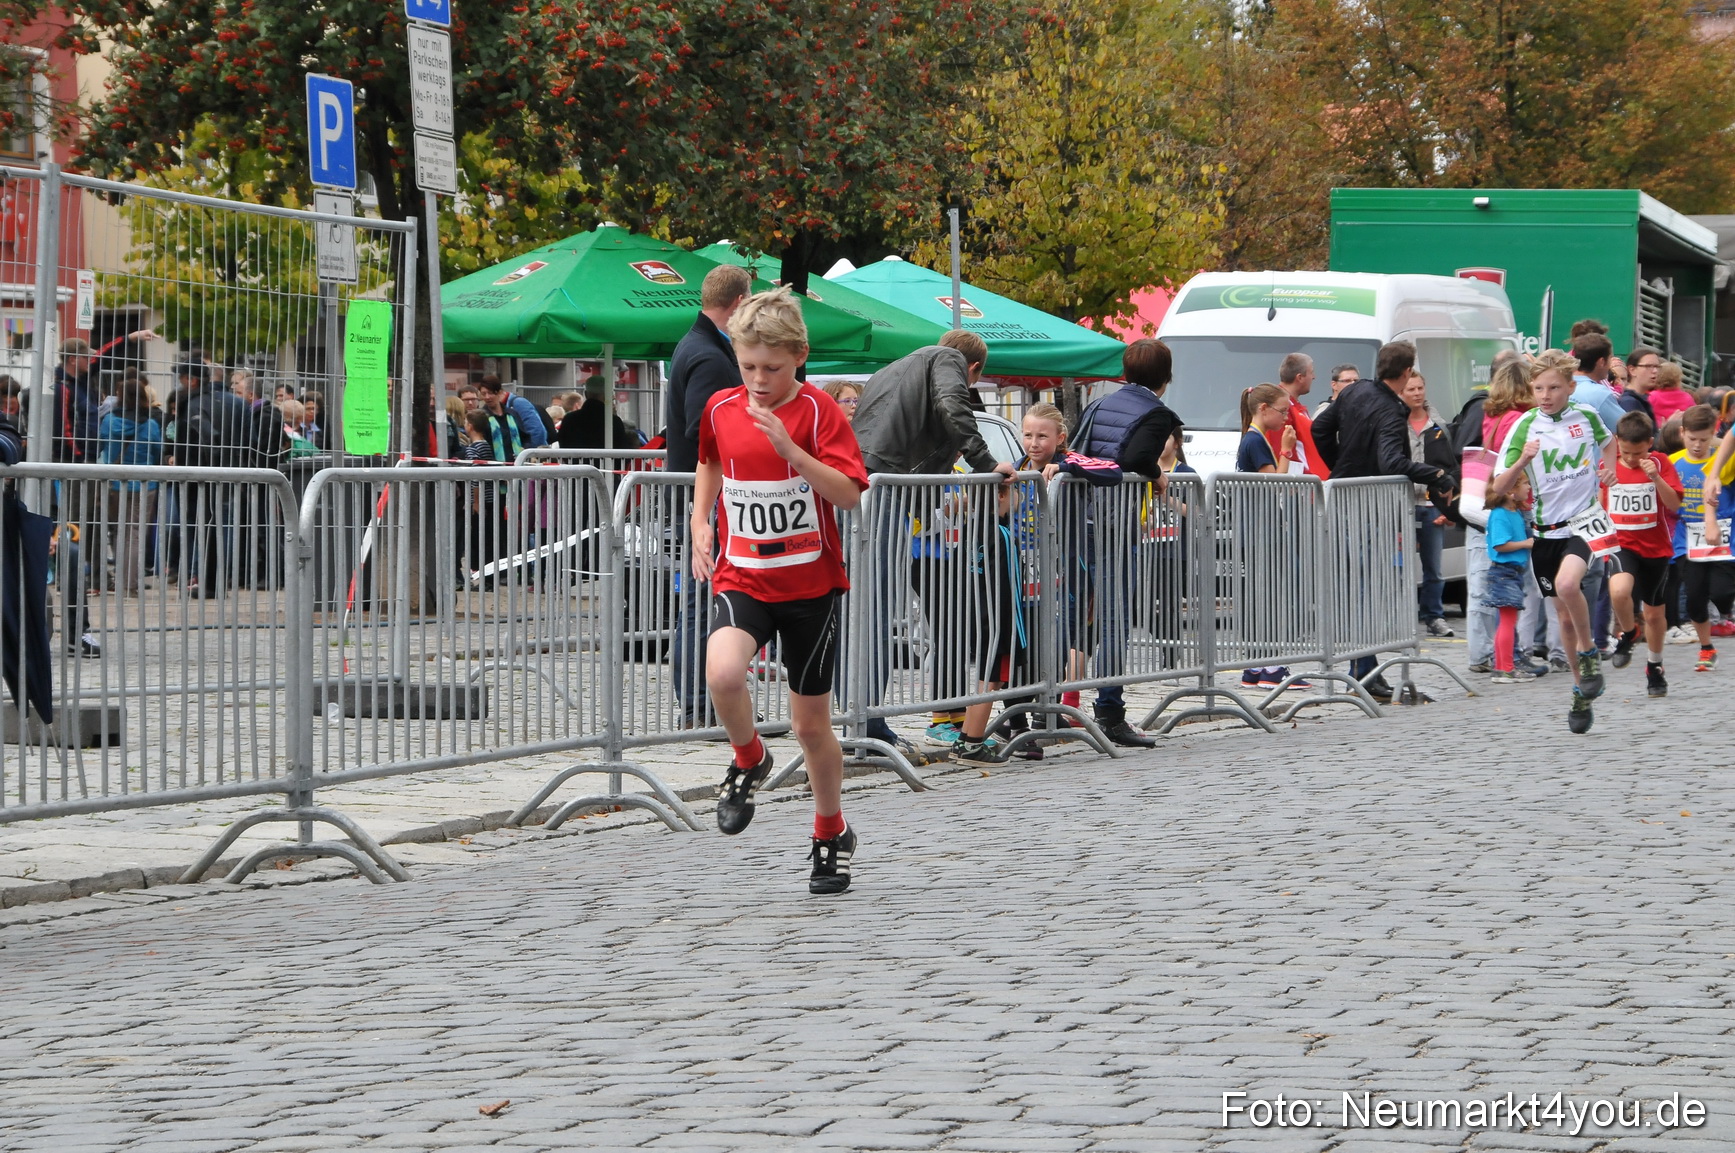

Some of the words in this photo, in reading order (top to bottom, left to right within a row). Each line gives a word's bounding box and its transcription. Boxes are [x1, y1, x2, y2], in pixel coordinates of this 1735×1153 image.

[417, 37, 428, 49] nur
[431, 38, 442, 52] mit
[413, 49, 448, 70] Parkschein
[417, 70, 446, 89] werktags
[416, 105, 424, 119] Sa
[318, 91, 343, 170] P
[631, 288, 702, 298] Neumar
[1272, 287, 1334, 297] Europcar
[622, 297, 703, 309] Lamm
[1260, 296, 1295, 304] moving
[1560, 468, 1590, 481] ENERGIE
[725, 486, 750, 498] PARTL
[751, 487, 796, 499] Neumarkt
[1612, 494, 1652, 512] 7050
[731, 499, 809, 535] 7002
[787, 537, 822, 552] Bastian
[1692, 529, 1731, 547] 75
